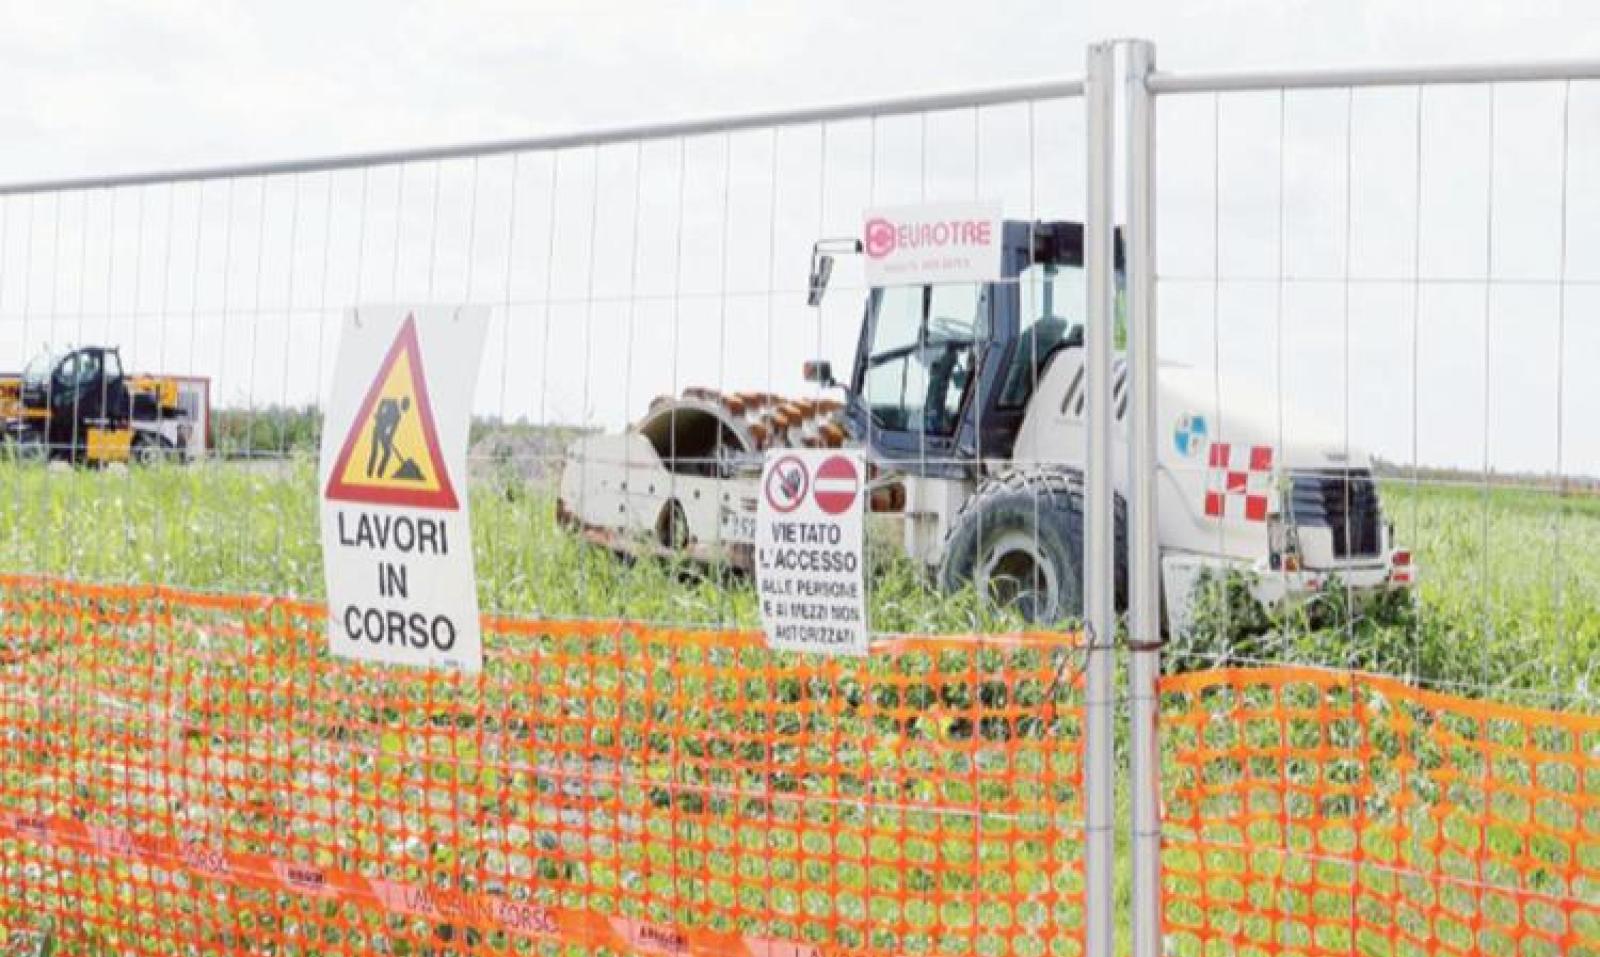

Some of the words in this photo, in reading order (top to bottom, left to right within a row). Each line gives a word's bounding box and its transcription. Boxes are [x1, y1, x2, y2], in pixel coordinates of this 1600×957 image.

[898, 220, 991, 248] EUROTRE
[338, 511, 448, 555] LAVORI
[771, 521, 841, 545] VIETATO
[759, 548, 857, 573] L'ACCESSO
[378, 562, 408, 599] IN
[797, 578, 857, 598] PERSONE
[790, 602, 829, 620] MEZZI
[344, 605, 456, 651] CORSO
